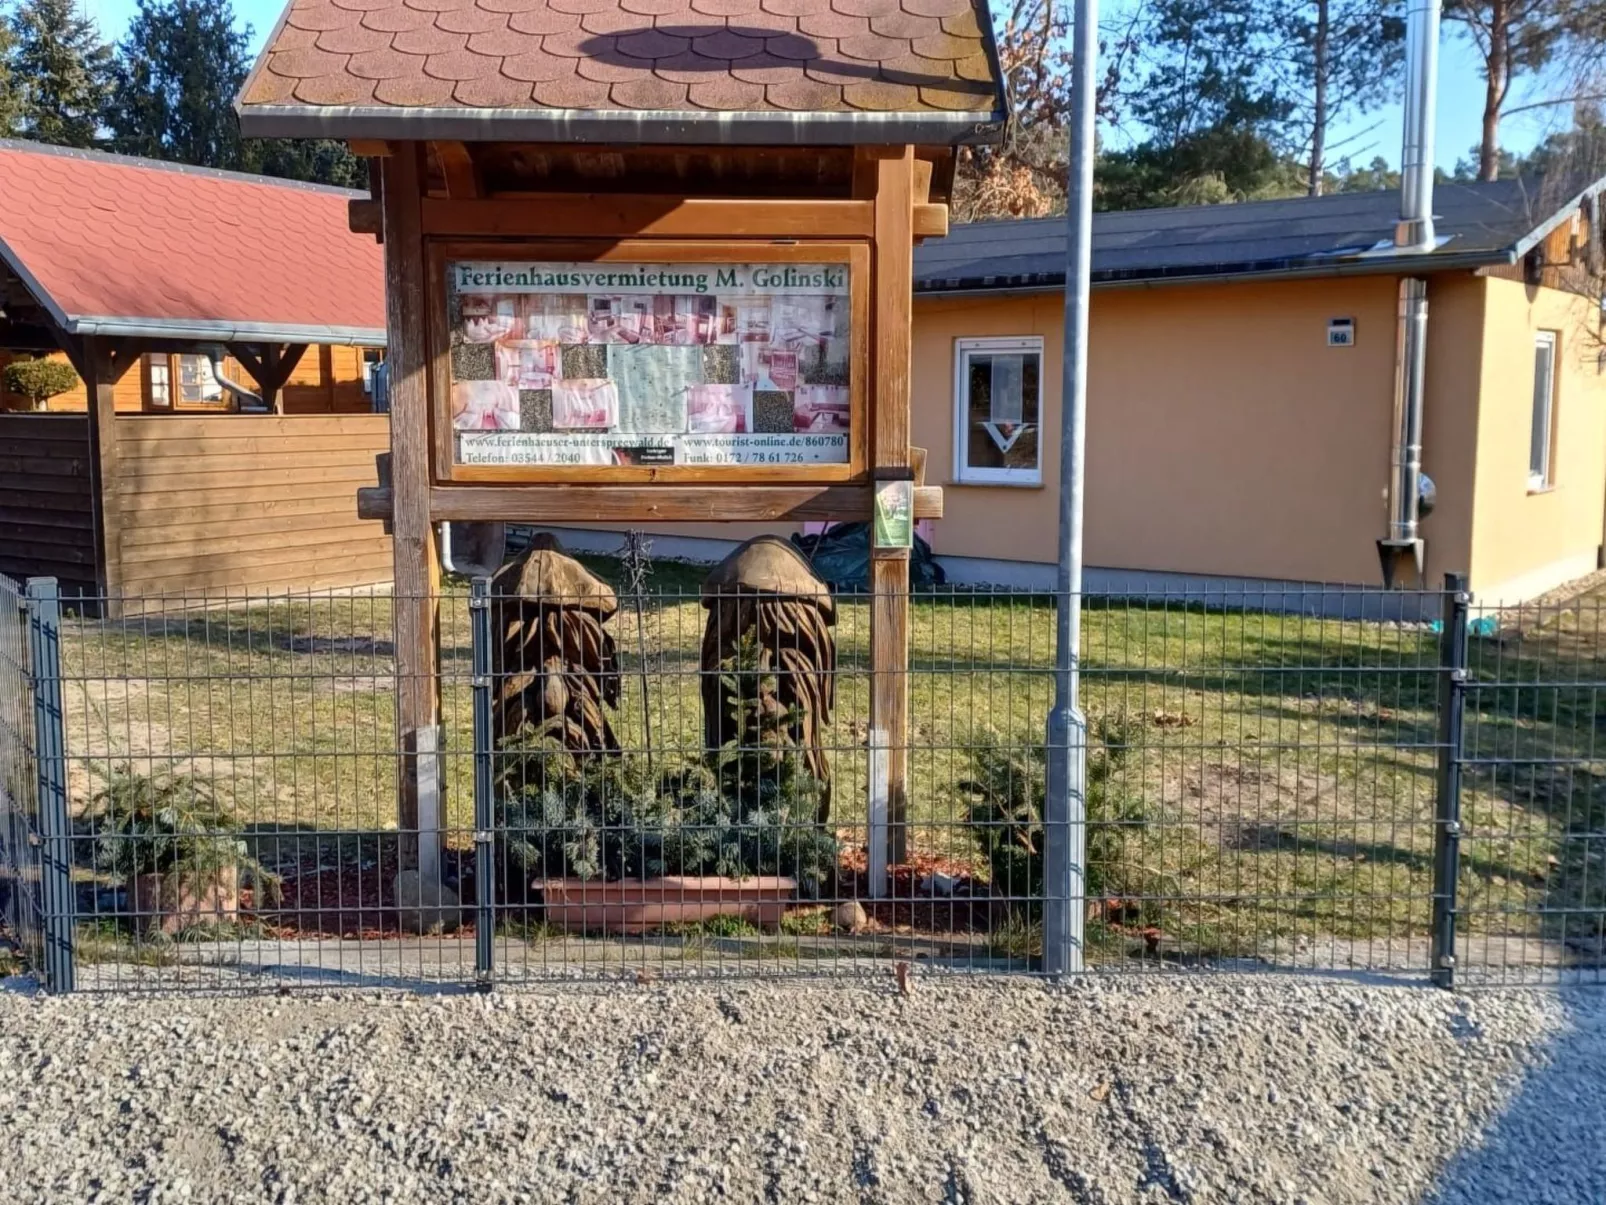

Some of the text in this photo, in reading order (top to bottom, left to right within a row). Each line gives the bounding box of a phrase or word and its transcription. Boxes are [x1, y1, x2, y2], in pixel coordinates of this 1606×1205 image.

[460, 266, 844, 292] Ferienhausvermietung M. Golinski
[1333, 333, 1347, 343] 60
[684, 436, 844, 447] www.tourist-online.de/860780
[466, 452, 509, 463] Telefon:
[555, 453, 581, 463] 2040
[684, 452, 713, 463] Funk:
[716, 452, 742, 463] 0172
[752, 452, 766, 463] 78
[768, 452, 780, 463] 61
[785, 452, 804, 463] 726
